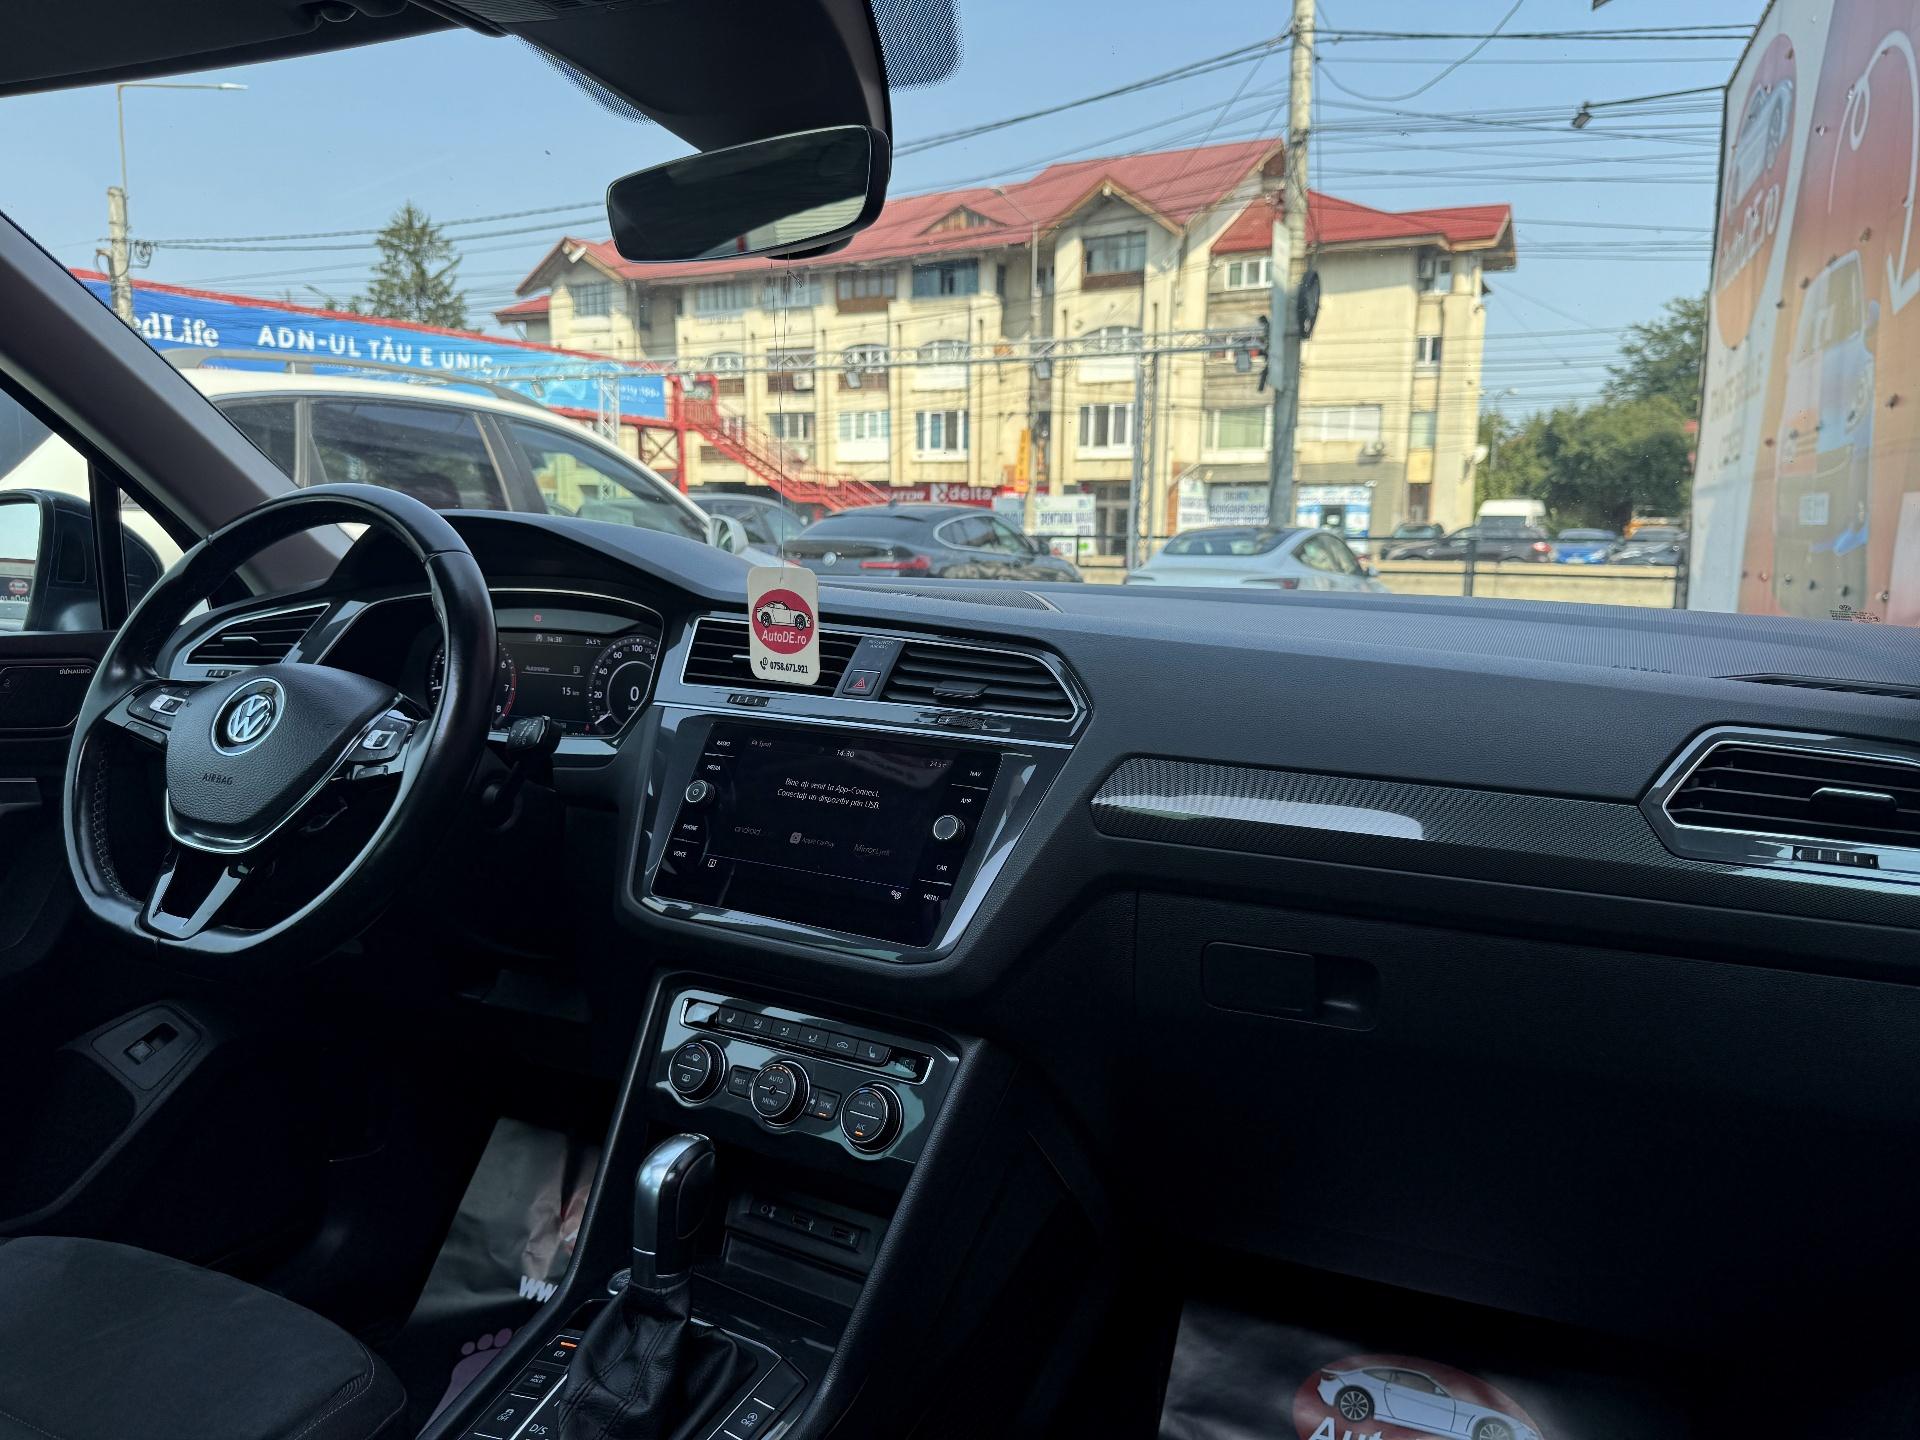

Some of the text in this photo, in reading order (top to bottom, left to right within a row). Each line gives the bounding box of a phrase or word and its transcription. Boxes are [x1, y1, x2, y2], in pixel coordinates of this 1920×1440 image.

[132, 312, 219, 348] edLife
[257, 325, 362, 358] ADN-UL
[368, 335, 412, 364] TĂU
[420, 347, 434, 367] E
[948, 484, 993, 500] delta
[761, 630, 807, 645] AutoDE.ro
[632, 644, 643, 652] 100
[613, 651, 623, 659] 60
[501, 661, 507, 669] 6
[769, 660, 809, 674] 0758.671.921
[504, 684, 510, 692] 7
[561, 687, 571, 696] 15
[593, 691, 603, 699] 20
[630, 686, 640, 702] 0
[496, 705, 502, 713] 8
[836, 749, 855, 758] 14:30
[202, 772, 234, 786] AIRBAG
[769, 1074, 784, 1084] AUTO
[740, 1418, 755, 1428] OFF
[529, 1423, 549, 1435] D/S
